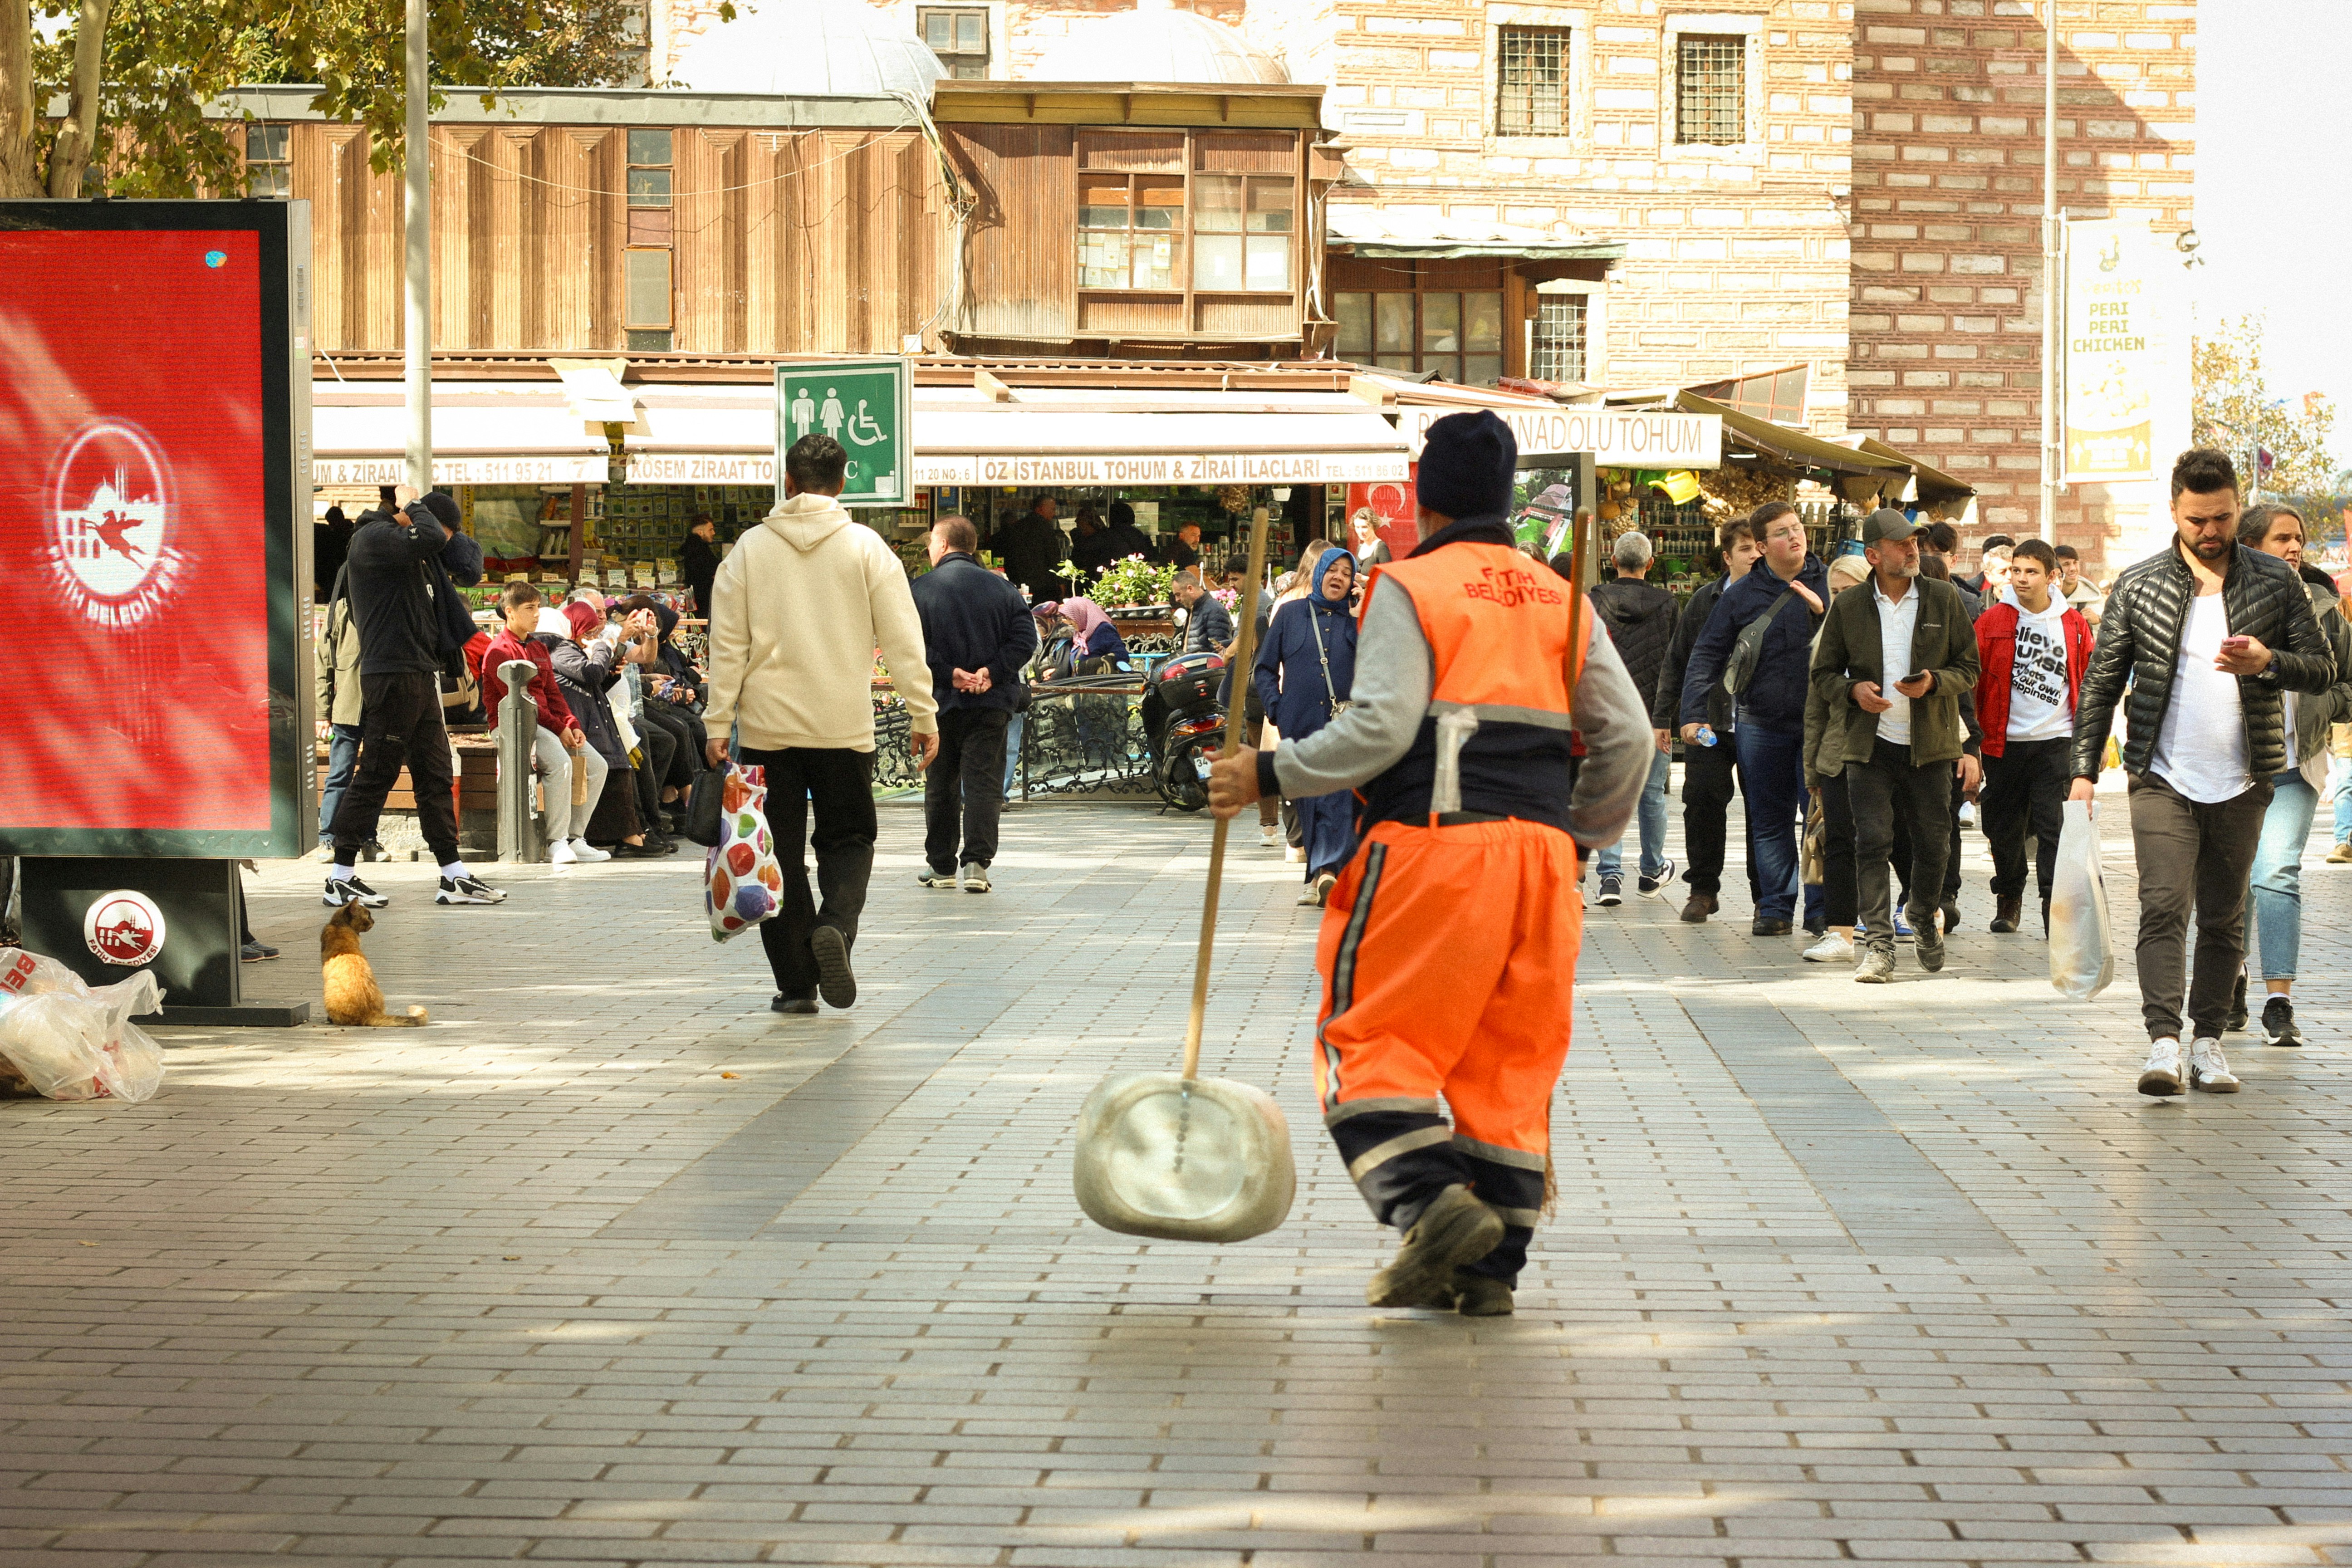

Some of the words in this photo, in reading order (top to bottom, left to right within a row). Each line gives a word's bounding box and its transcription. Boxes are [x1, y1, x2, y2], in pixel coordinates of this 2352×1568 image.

[2089, 302, 2129, 317] PERI
[2089, 319, 2129, 334] PERI
[2073, 337, 2145, 353] CHICKEN
[1618, 417, 1701, 454] TOHUM
[338, 464, 348, 483] &
[445, 463, 471, 482] TEL
[485, 462, 509, 481] 511
[515, 462, 532, 481] 95
[537, 462, 552, 480] 21
[573, 460, 588, 479] 7
[691, 456, 747, 480] ZİRAAT
[928, 469, 939, 480] 20
[942, 469, 956, 480] NO
[965, 469, 970, 480] 6
[985, 457, 1008, 480] ÖZ
[1014, 456, 1099, 480] İSTANBUL
[1104, 461, 1166, 480] TOHUM
[1173, 461, 1185, 480] &
[1326, 466, 1345, 477] TEL
[1355, 465, 1372, 477] 511
[1392, 465, 1404, 476] 02
[1196, 757, 1208, 767] 34
[88, 939, 109, 963] FATİH
[110, 944, 158, 967] EDİYESİ
